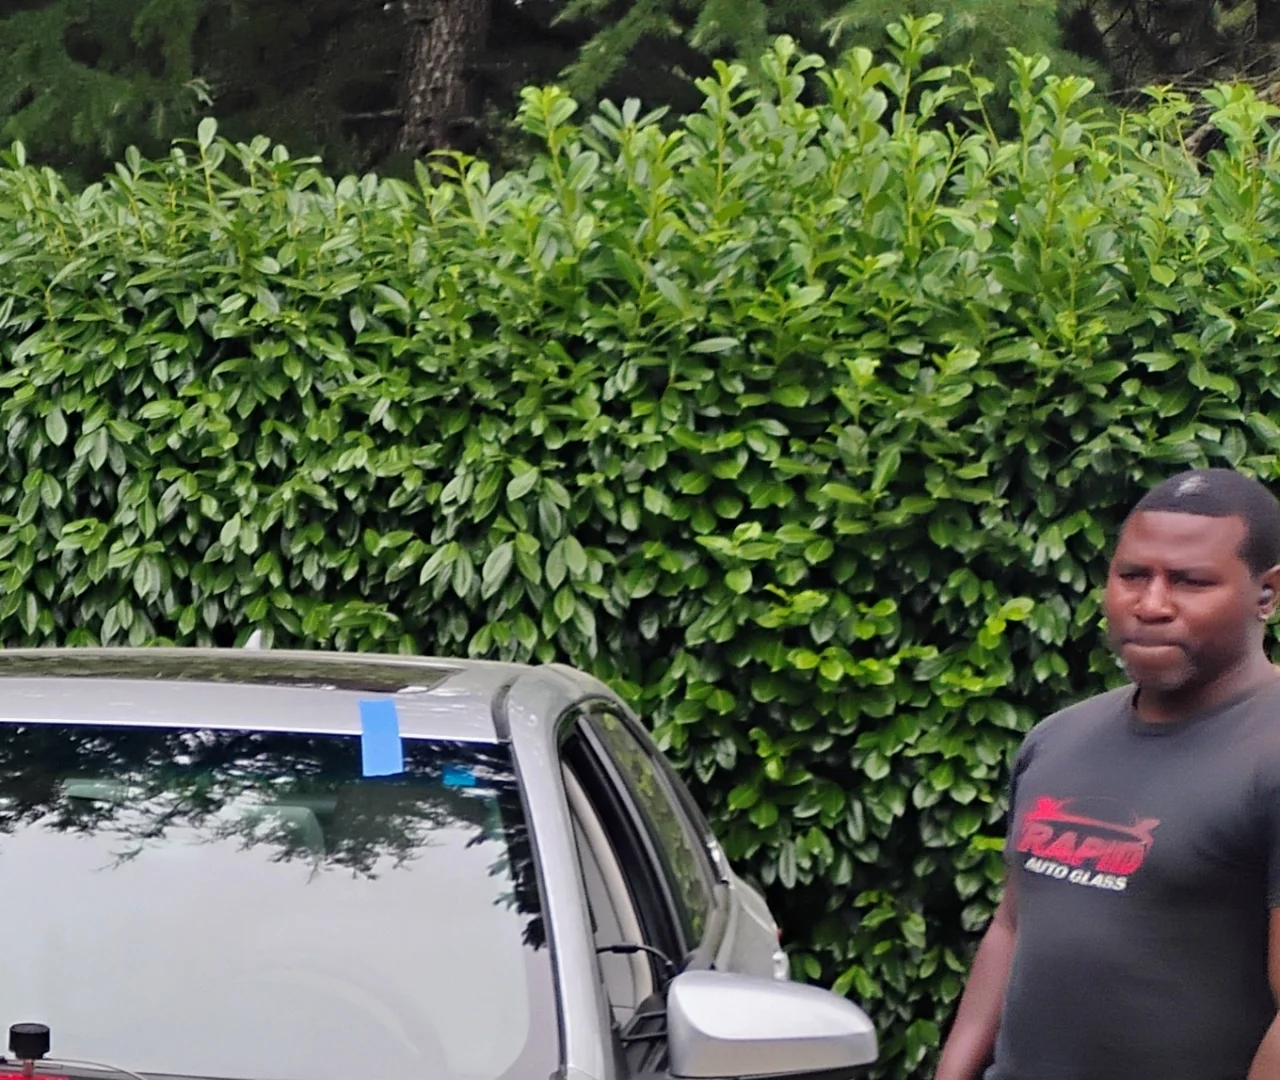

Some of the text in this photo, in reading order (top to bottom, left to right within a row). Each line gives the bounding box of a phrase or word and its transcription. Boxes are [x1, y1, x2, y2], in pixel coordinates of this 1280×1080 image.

[1017, 821, 1147, 875] RAPID
[1024, 857, 1128, 892] AUTO GLASS
